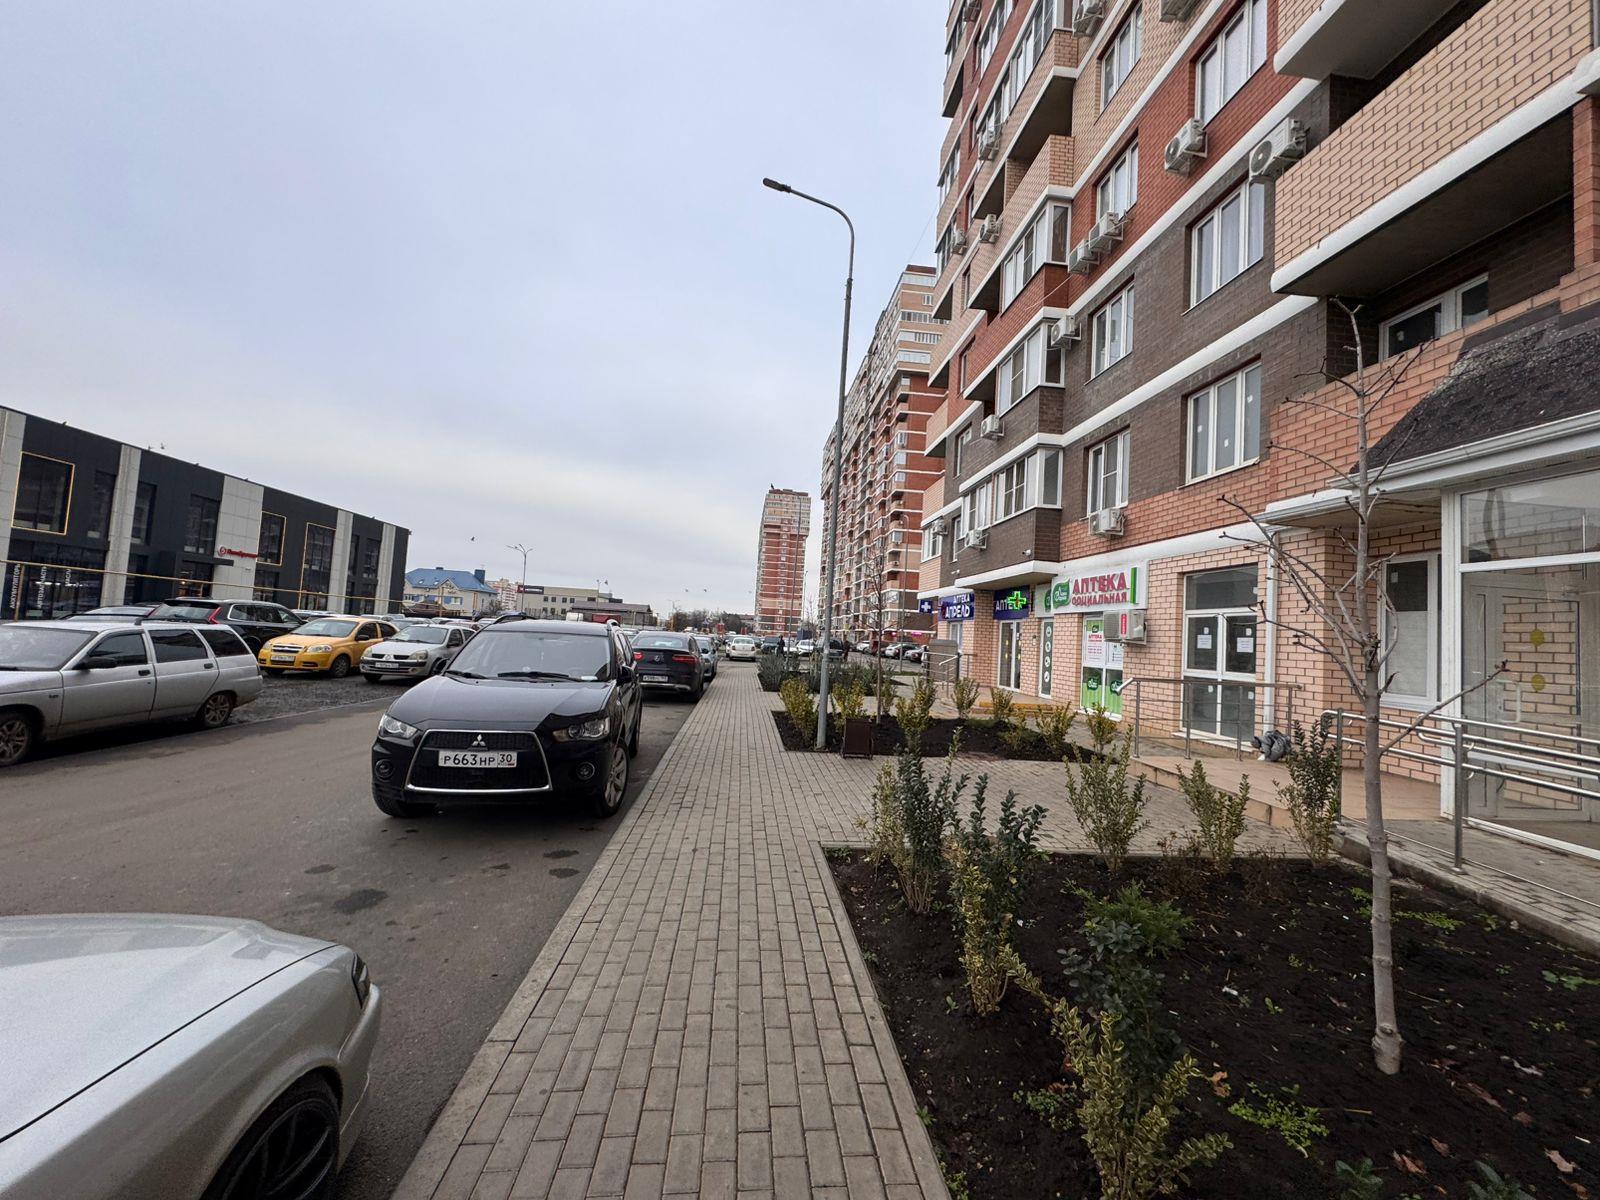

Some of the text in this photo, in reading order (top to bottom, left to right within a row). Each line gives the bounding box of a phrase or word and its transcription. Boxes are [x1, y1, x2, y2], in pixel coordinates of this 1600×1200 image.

[1072, 572, 1127, 595] АПТЕКА
[953, 592, 970, 604] АПТЕКА
[1071, 591, 1127, 607] СОЦИАЛЬНАЯ
[944, 602, 970, 618] АПРЕЛЬ
[443, 753, 513, 766] Р663НР 30
